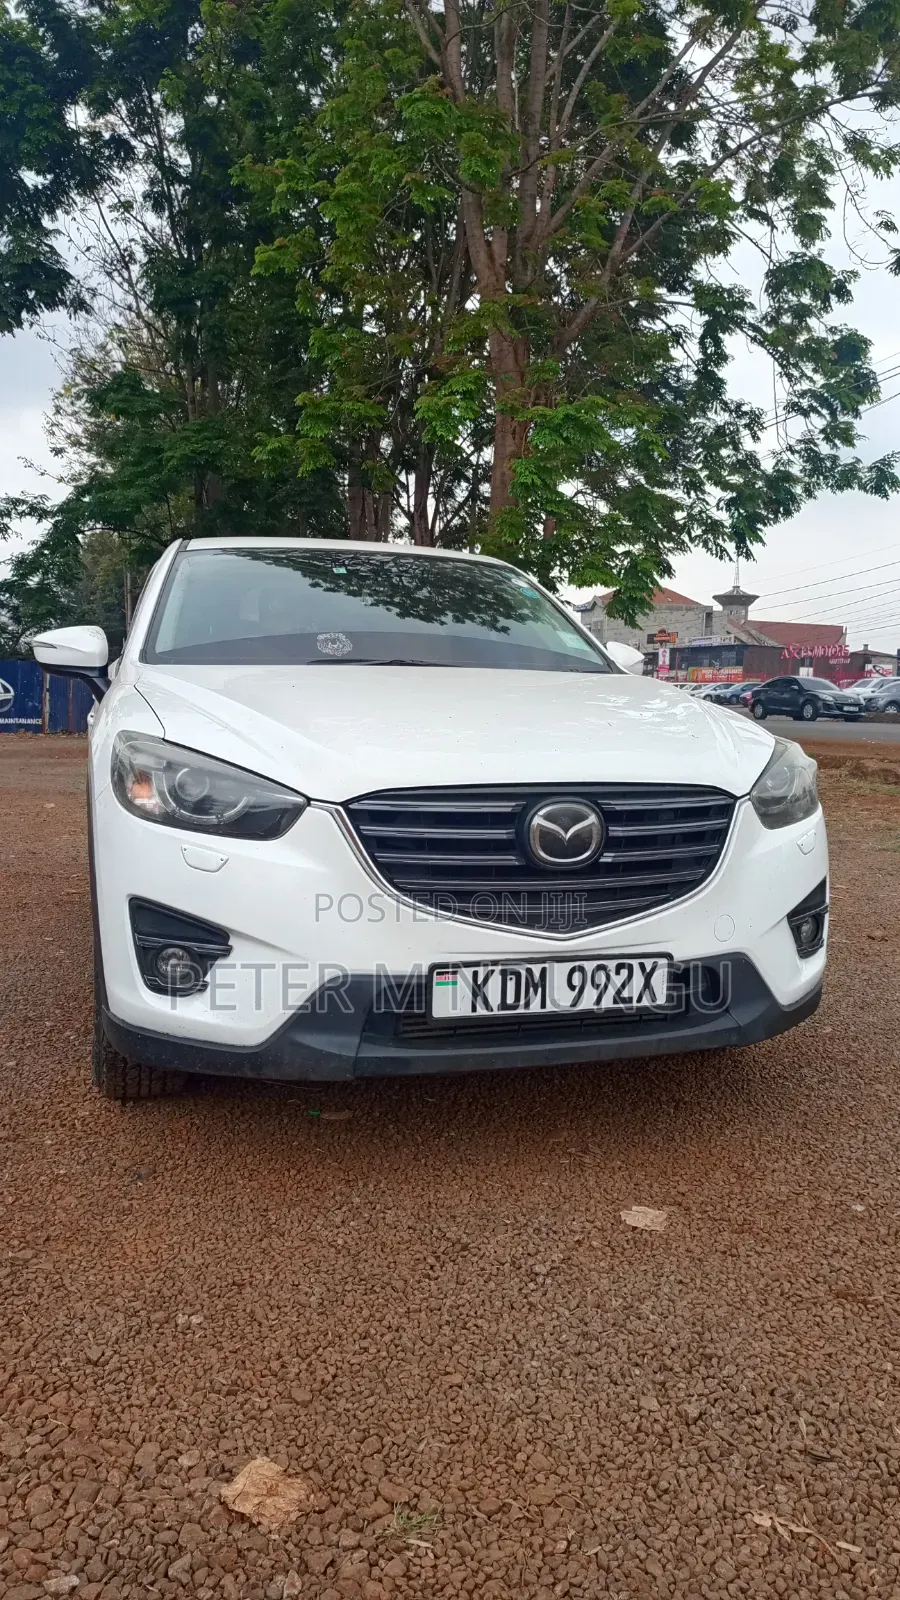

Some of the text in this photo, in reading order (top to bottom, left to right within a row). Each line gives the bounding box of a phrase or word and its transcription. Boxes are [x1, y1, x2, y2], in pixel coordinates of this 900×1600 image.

[812, 644, 851, 657] MOTORS
[471, 966, 548, 1013] KDM
[566, 960, 659, 1008] 992X
